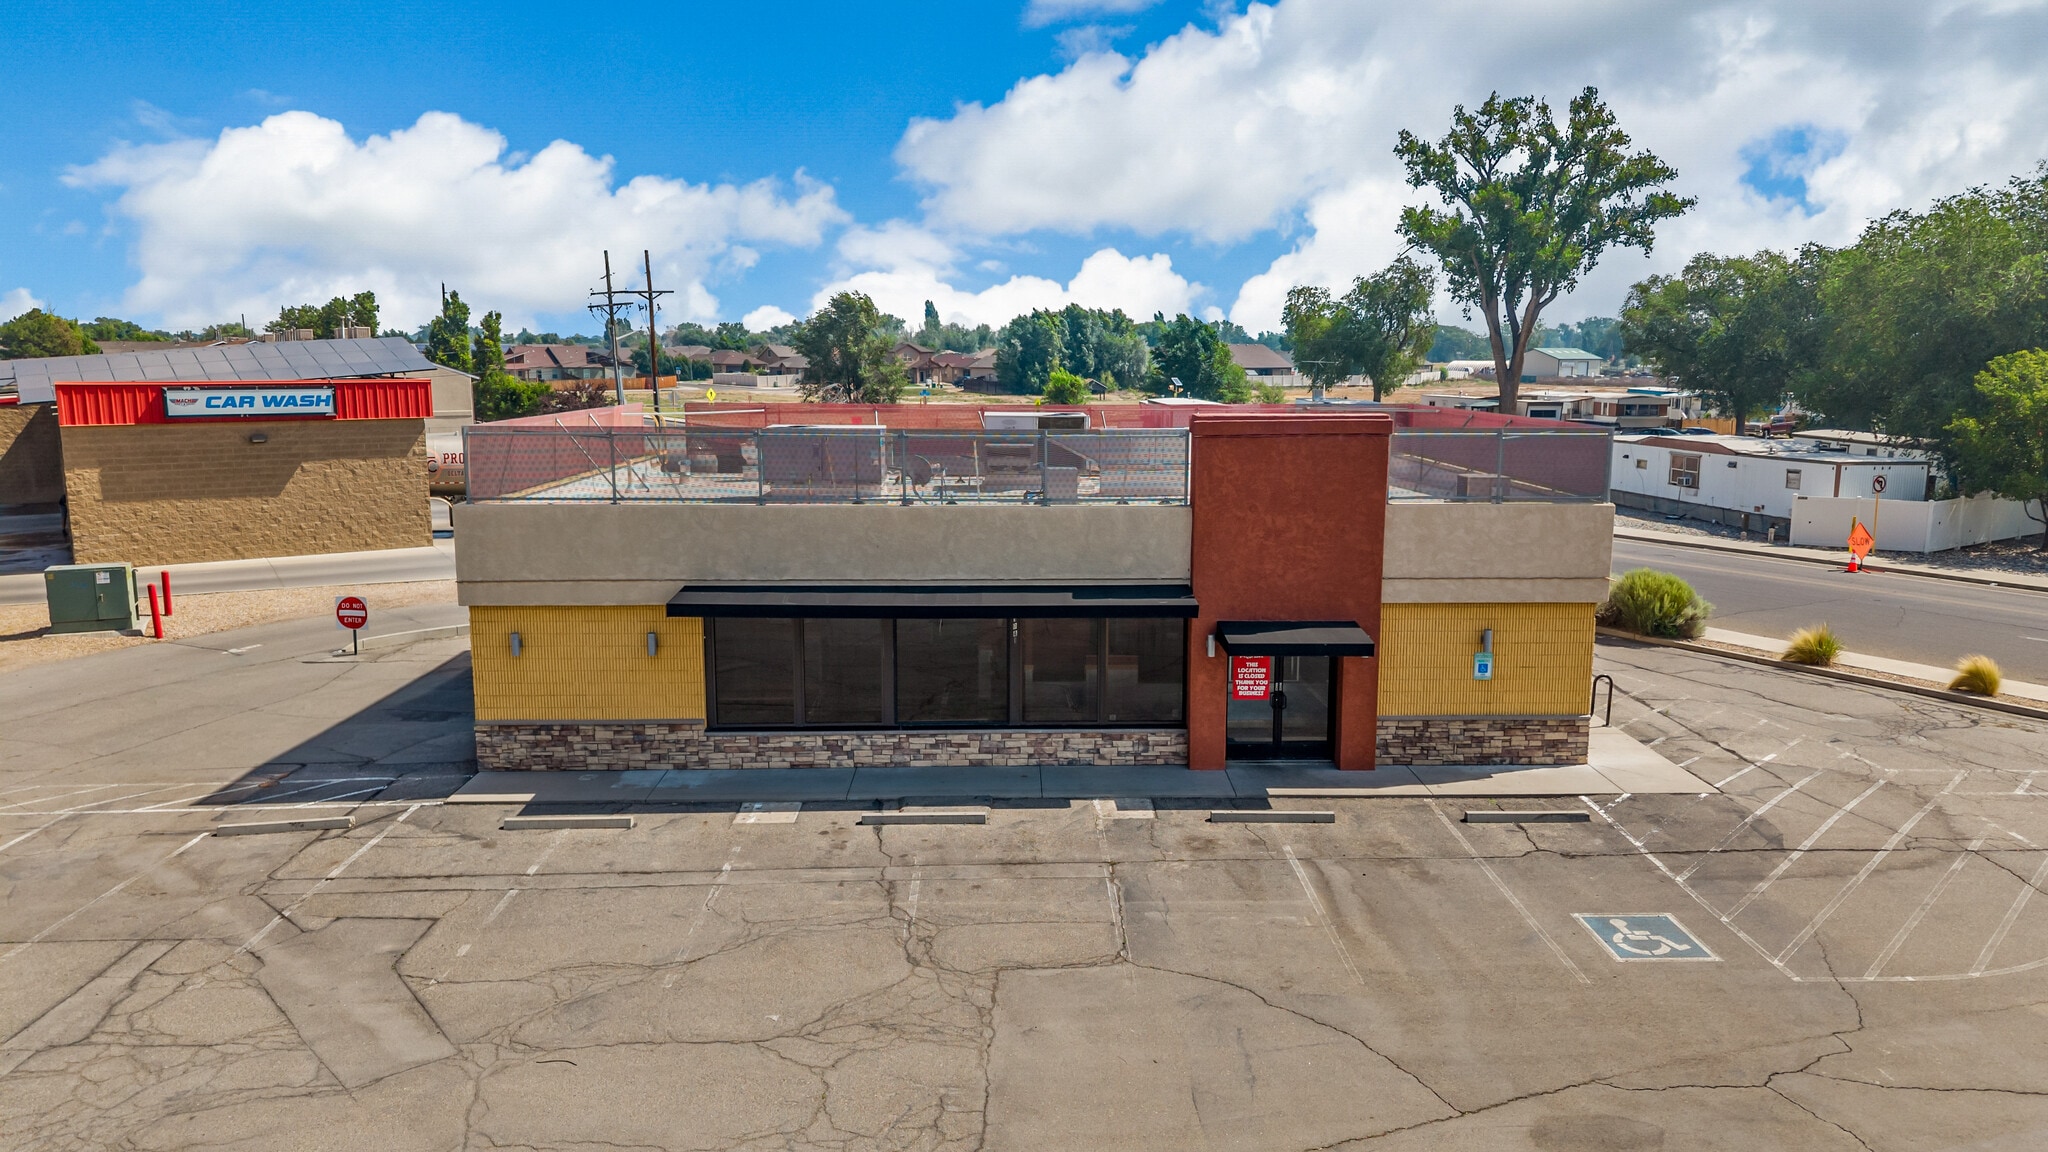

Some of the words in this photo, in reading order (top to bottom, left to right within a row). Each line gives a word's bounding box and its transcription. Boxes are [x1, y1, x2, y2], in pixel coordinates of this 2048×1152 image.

[205, 396, 255, 408] CAR
[262, 395, 332, 408] WASH
[1851, 536, 1870, 546] SLOW
